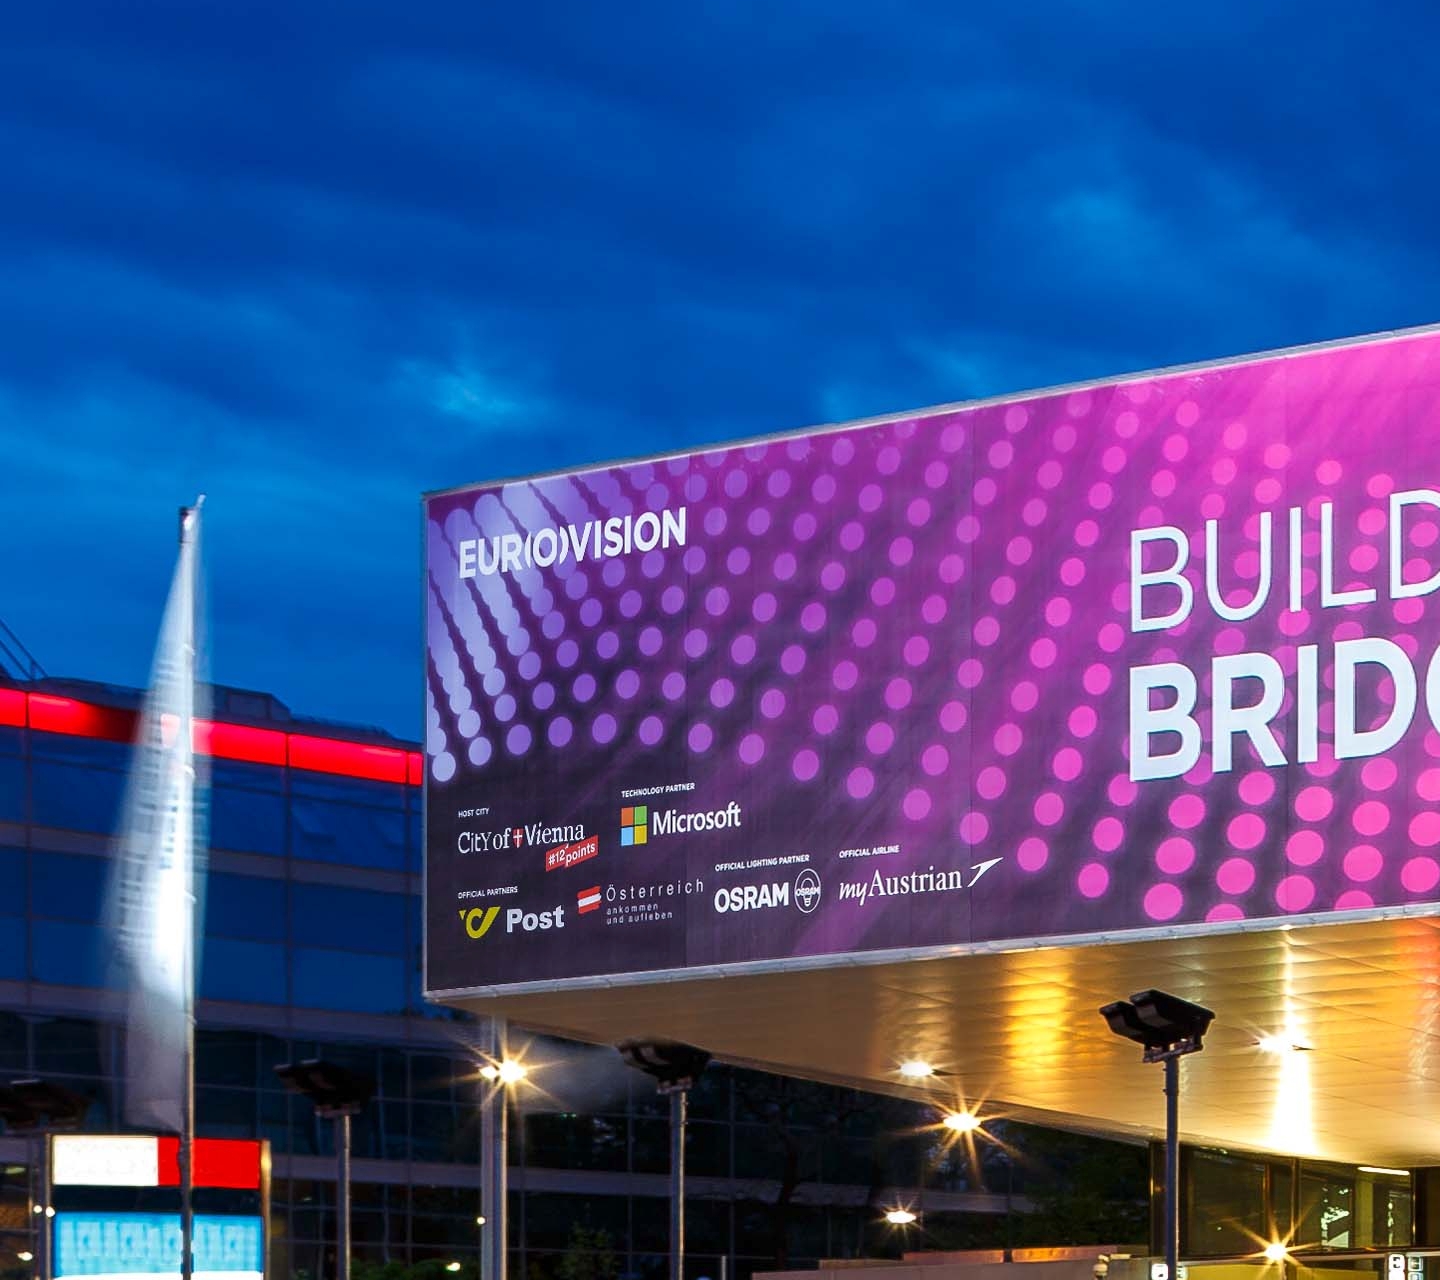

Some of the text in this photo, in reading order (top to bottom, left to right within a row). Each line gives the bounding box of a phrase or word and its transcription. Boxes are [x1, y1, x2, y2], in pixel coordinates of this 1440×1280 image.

[621, 782, 695, 798] TECHNOLOGY PARTNER
[458, 807, 490, 818] HOST CITY
[652, 801, 741, 836] Microsoft
[524, 821, 586, 846] Vienna
[839, 845, 900, 859] OFFICIAL AIRLINE
[714, 854, 810, 872] OFFICIAL LIGHTING PARTNER
[458, 886, 518, 900] OFFICIAL PARTNERS
[606, 878, 704, 902] Österreich
[714, 882, 789, 913] OSRAM
[795, 885, 821, 897] OSRAM
[606, 903, 658, 916] ankommen
[506, 905, 565, 933] Post
[607, 914, 624, 925] und
